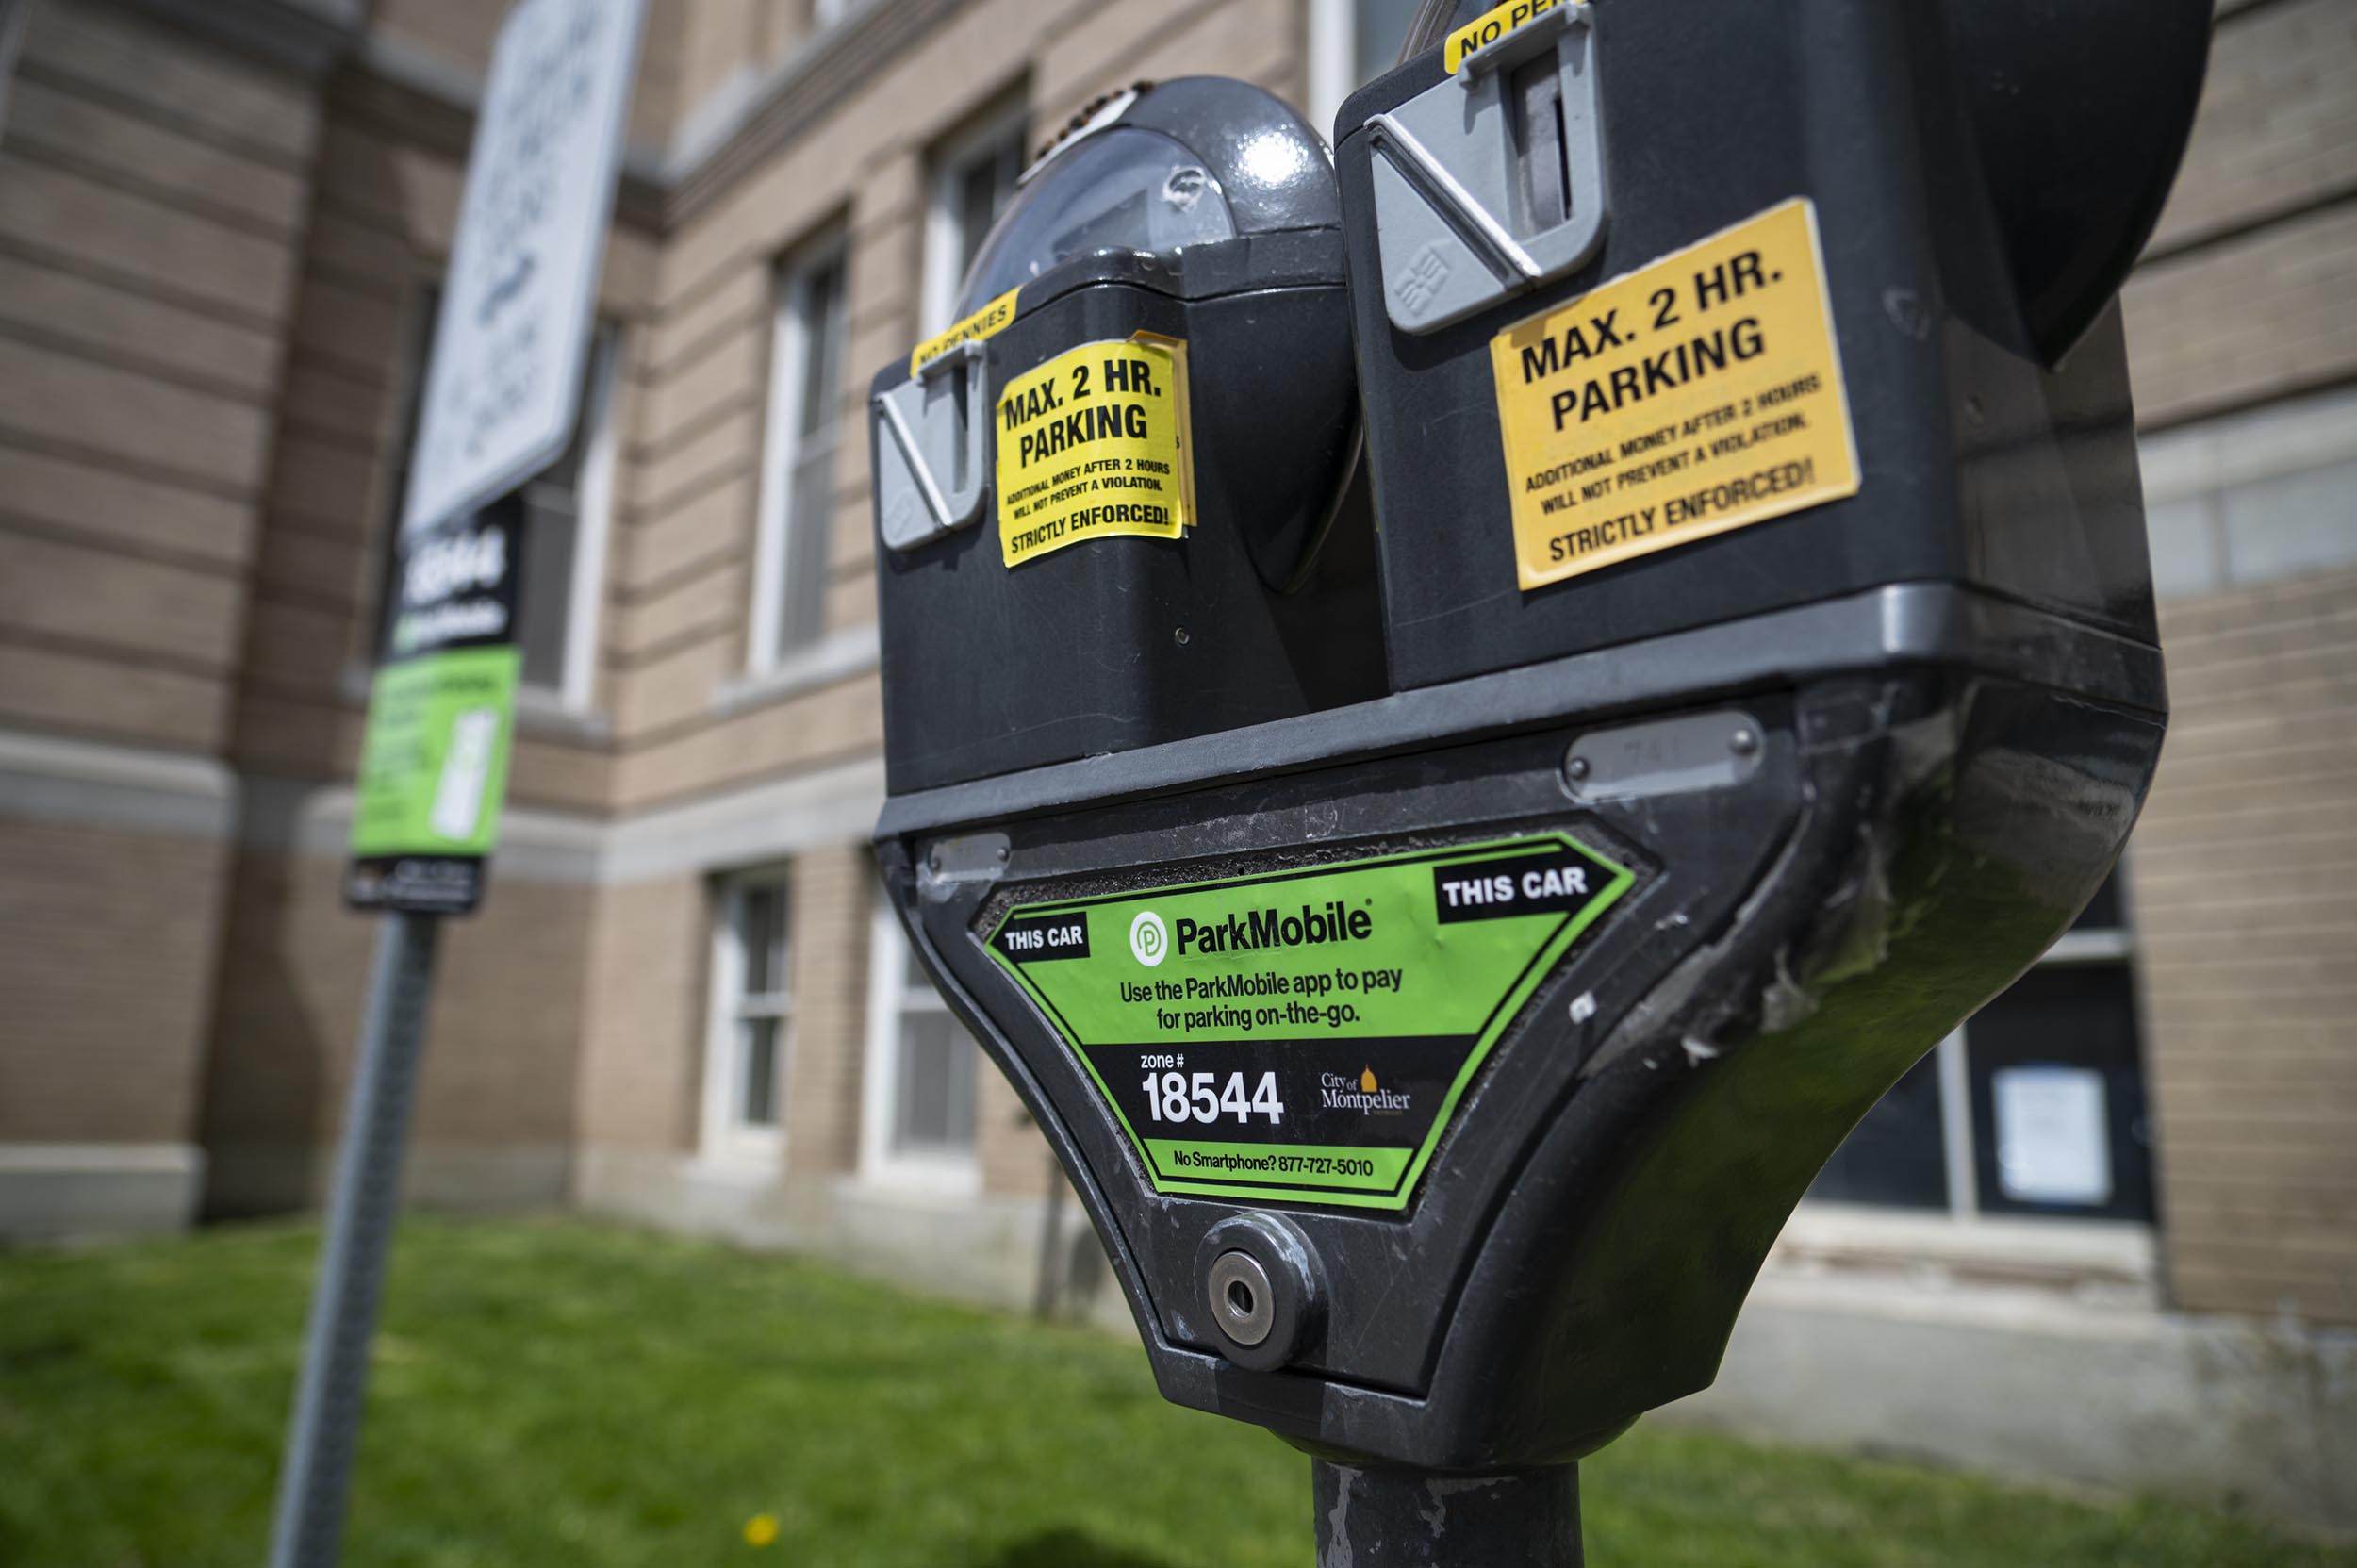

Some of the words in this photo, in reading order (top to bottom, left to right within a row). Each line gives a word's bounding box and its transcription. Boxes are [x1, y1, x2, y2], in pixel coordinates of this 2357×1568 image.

[1461, 21, 1501, 58] NO
[1521, 308, 1636, 384] MAX.
[1648, 287, 1681, 332] 2
[1693, 249, 1783, 311] HR.
[1004, 376, 1063, 431] MAX.
[1072, 365, 1091, 400] 2
[1104, 359, 1161, 397] HR.
[1551, 316, 1765, 432] PARKING
[1020, 404, 1147, 469] PARKING
[1525, 448, 1615, 493] ADDITIONAL
[1619, 425, 1677, 459] MONEY
[1682, 404, 1737, 437] AFTER
[1741, 397, 1752, 416] 2
[1757, 374, 1821, 409] HOURS
[1007, 478, 1049, 505] ADDITIONAL
[1052, 466, 1081, 488] MONEY
[1084, 458, 1120, 474] AFTER
[1125, 458, 1132, 470] 2
[1137, 459, 1170, 475] HOURS
[1541, 489, 1578, 515] WILL
[1581, 477, 1612, 503] NOT
[1617, 450, 1689, 490] PREVENT
[1694, 447, 1706, 463] A
[1710, 412, 1807, 457] VIOLATION.
[1014, 504, 1031, 520] WILL
[1033, 497, 1047, 512] NOT
[1050, 481, 1088, 504] PREVENT
[1091, 479, 1098, 491] A
[1101, 476, 1162, 491] VIOLATION.
[1549, 506, 1656, 562] STRICTLY
[1664, 455, 1816, 526] ENFORCED!
[1012, 517, 1066, 554] STRICTLY
[1071, 503, 1169, 531] ENFORCED!
[1442, 878, 1515, 907] THIS
[1522, 866, 1589, 898] CAR
[1005, 930, 1044, 951] THIS
[1047, 925, 1084, 947] CAR
[1176, 900, 1372, 955] ParkMobile
[1120, 982, 1152, 1002] Use
[1155, 980, 1183, 1000] the
[1185, 972, 1290, 999] ParkMobile
[1293, 973, 1332, 998] app
[1335, 967, 1359, 990] to
[1362, 968, 1403, 994] pay
[1157, 1007, 1181, 1029] for
[1184, 1004, 1253, 1033] parking
[1255, 1000, 1360, 1028] on-the-go.
[1141, 1052, 1174, 1069] zone
[1177, 1053, 1184, 1068] #
[1321, 1072, 1346, 1093] City
[1346, 1078, 1359, 1091] of
[1142, 1070, 1285, 1125] 18544
[1320, 1088, 1410, 1115] Montpelier
[1174, 1150, 1192, 1167] No
[1193, 1151, 1275, 1176] Smartphone?
[1278, 1157, 1374, 1177] 877-727-5010
